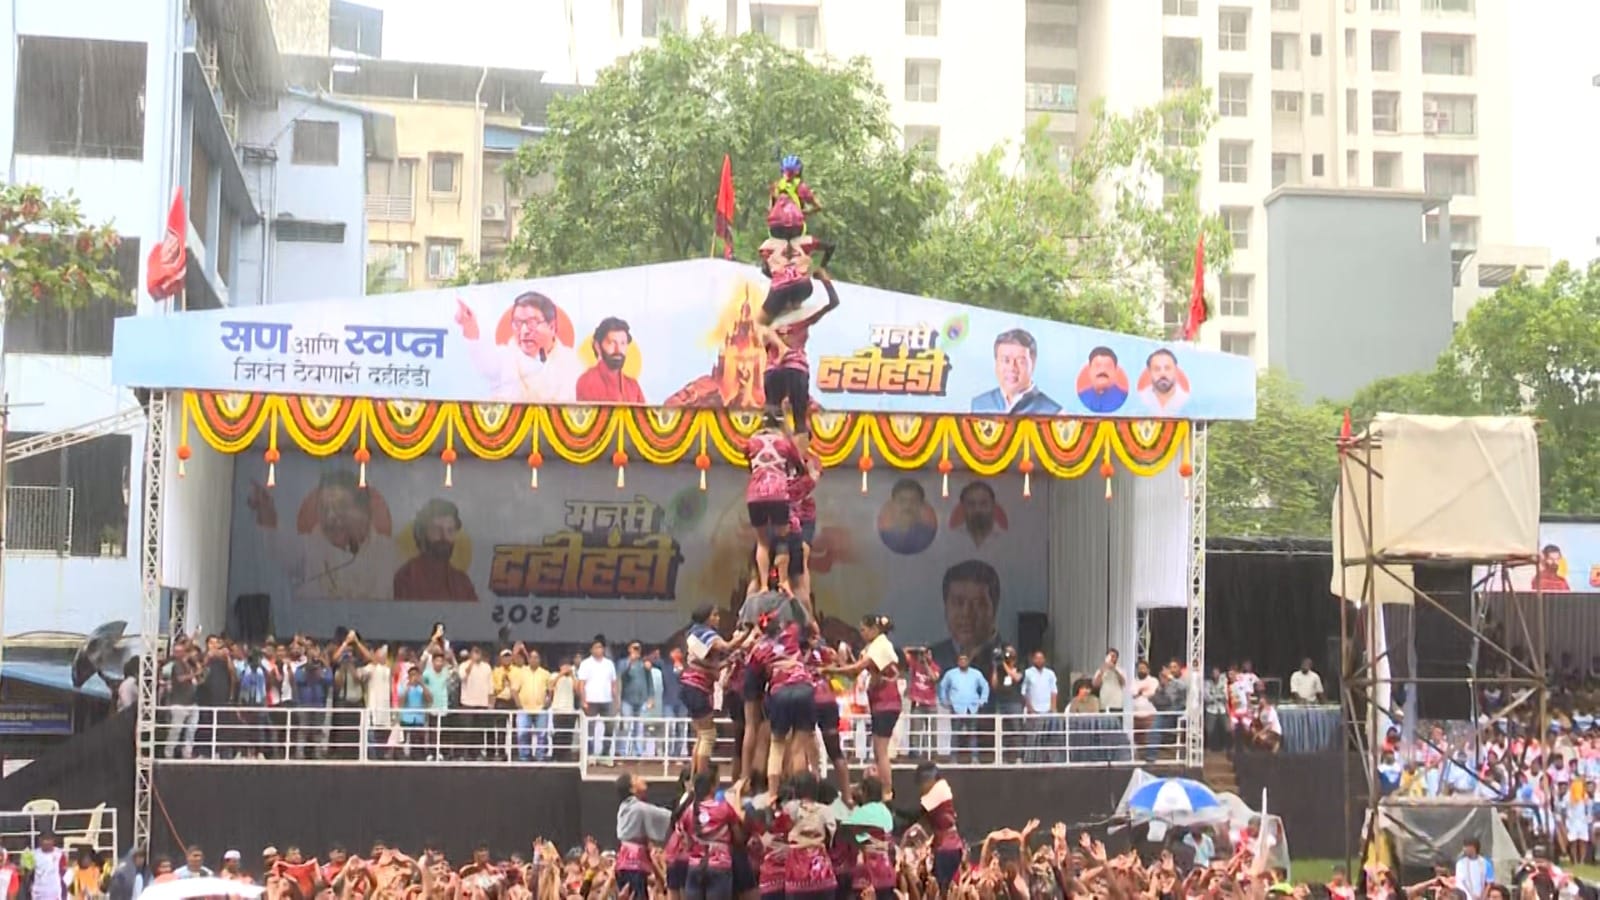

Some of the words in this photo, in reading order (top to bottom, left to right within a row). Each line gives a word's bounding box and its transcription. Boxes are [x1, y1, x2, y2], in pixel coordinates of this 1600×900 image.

[220, 321, 292, 354] सण
[294, 332, 338, 354] आणि
[344, 325, 448, 358] स्वप्न
[869, 320, 938, 350] मनसे
[234, 356, 286, 382] जिवंत
[293, 359, 360, 384] ठेवणारी
[367, 363, 430, 387] दहीहंडी
[817, 346, 952, 396] दहीहंडी
[565, 495, 664, 535] मनसे
[490, 531, 684, 600] दहीहंडी
